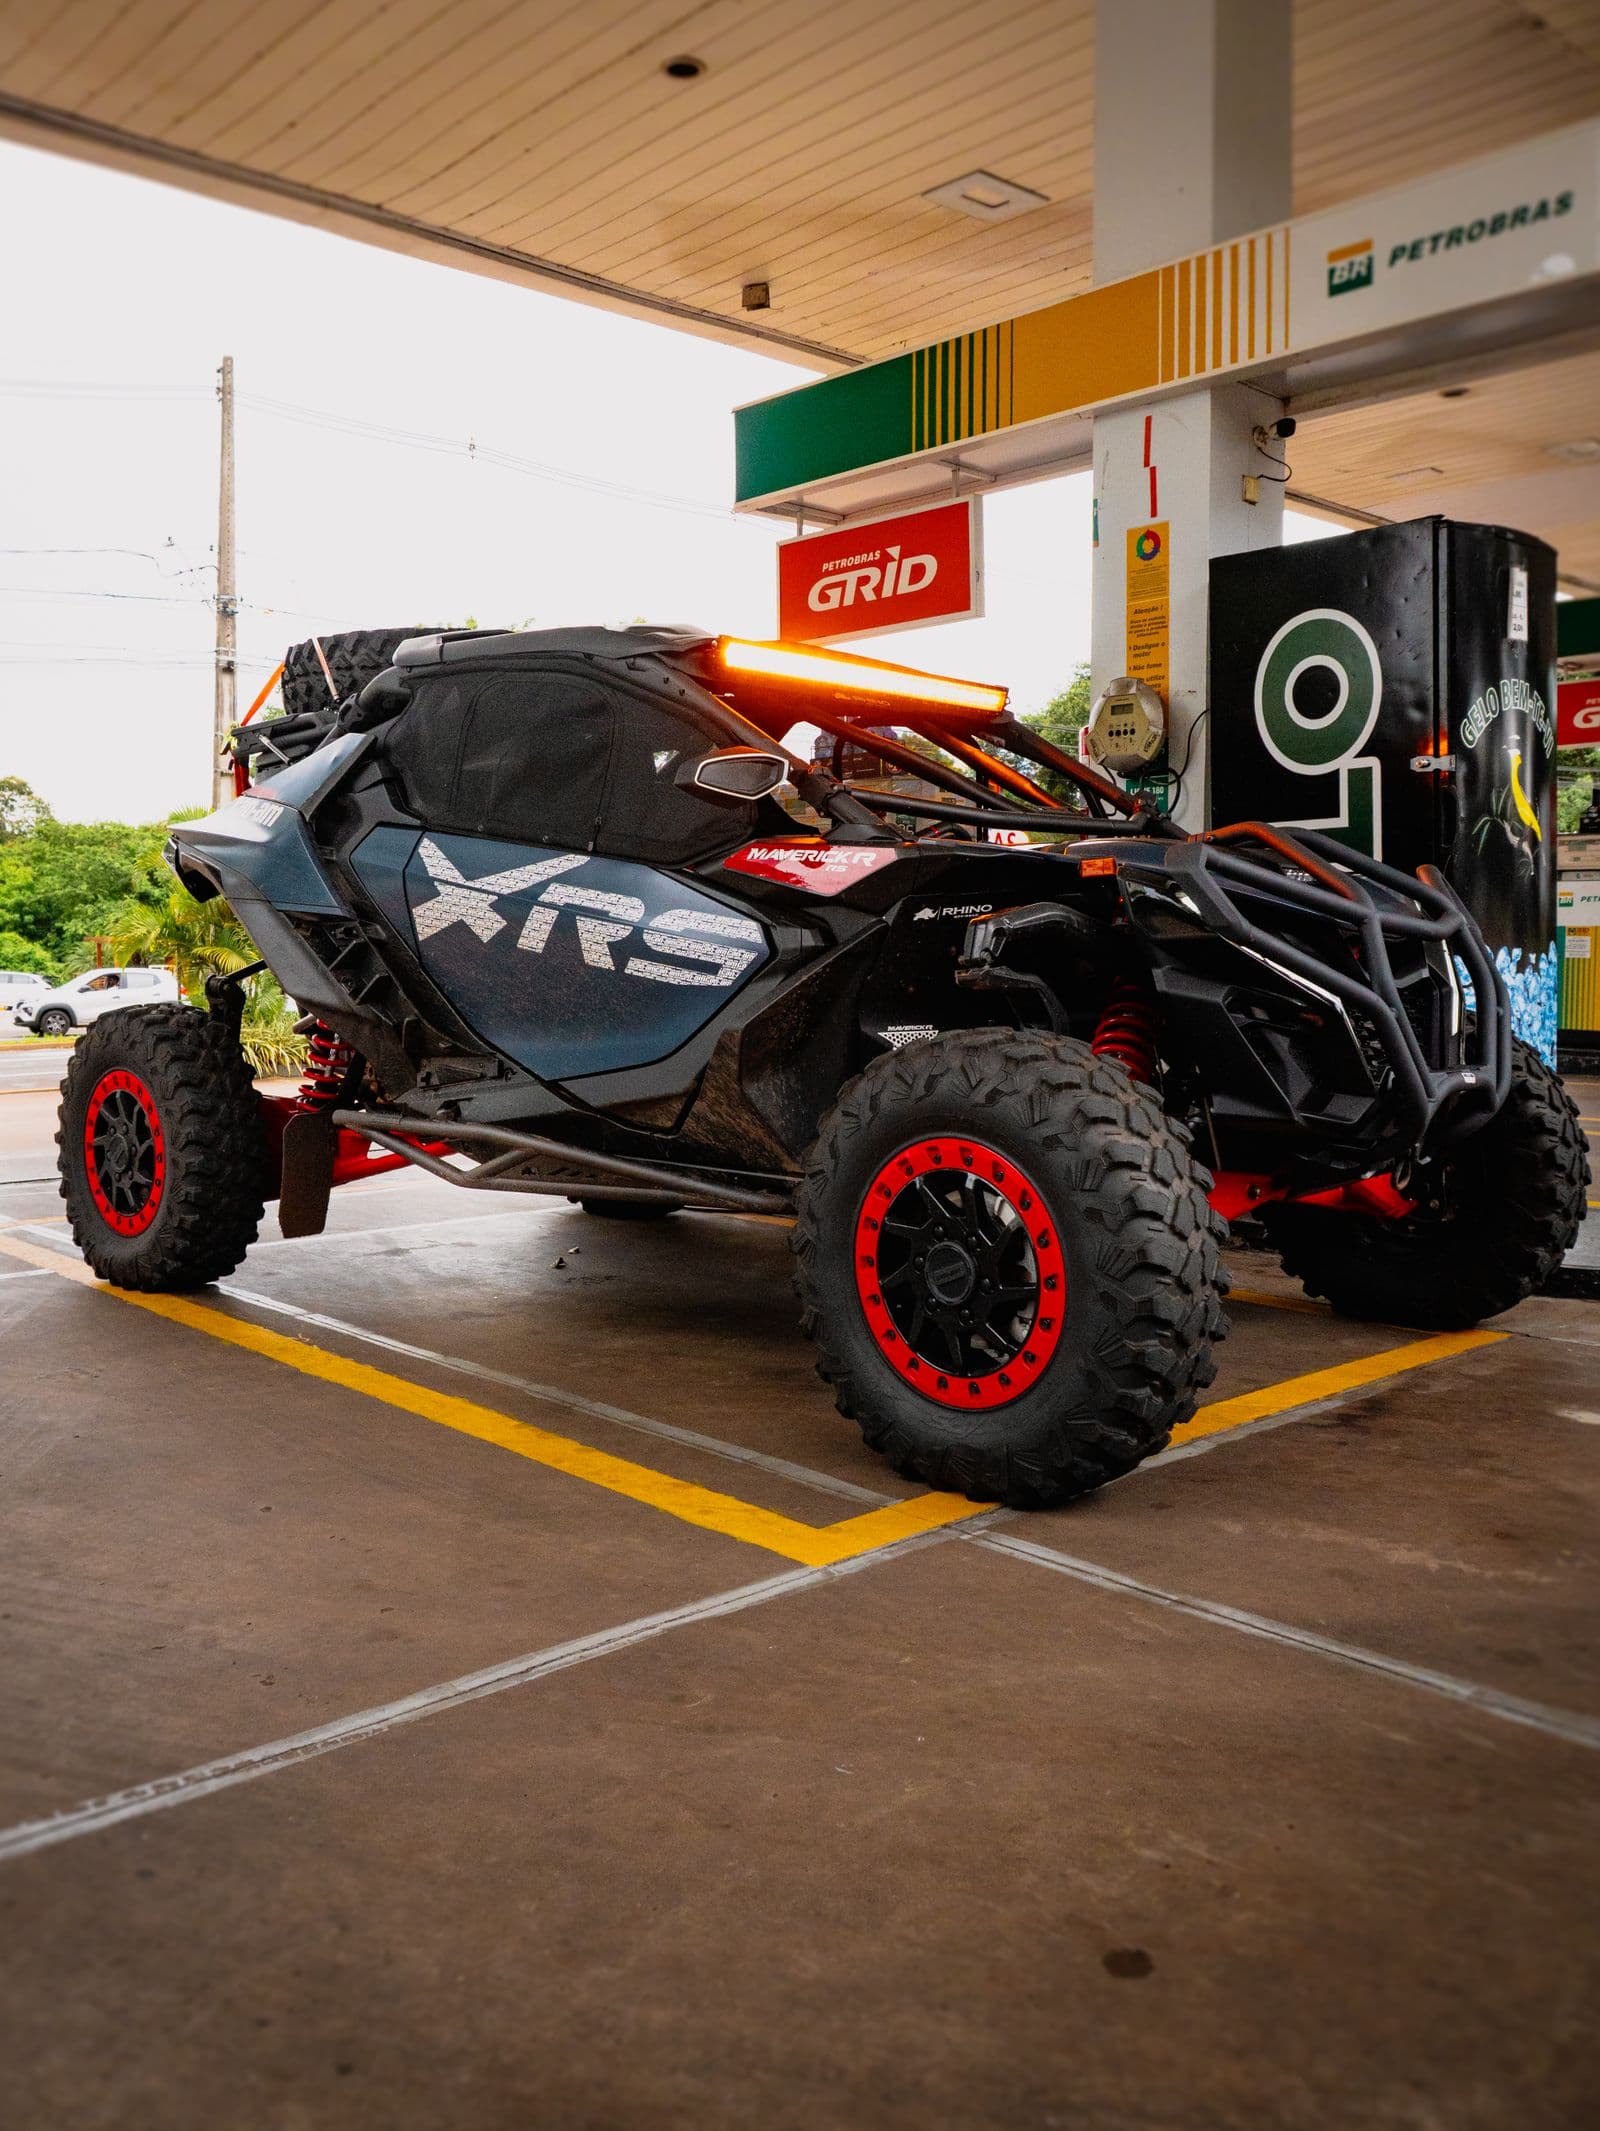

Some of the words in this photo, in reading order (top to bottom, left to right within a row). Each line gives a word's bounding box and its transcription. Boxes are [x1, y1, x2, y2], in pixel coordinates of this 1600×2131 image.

[1388, 190, 1575, 268] PETROBRAS
[807, 546, 938, 612] GRID
[822, 550, 881, 573] PETROBRAS
[1461, 687, 1500, 748] GELO
[1151, 786, 1165, 794] 180
[746, 847, 850, 864] MAVERICK
[850, 851, 877, 867] R
[412, 836, 764, 987] XRS
[941, 904, 993, 916] RHINO
